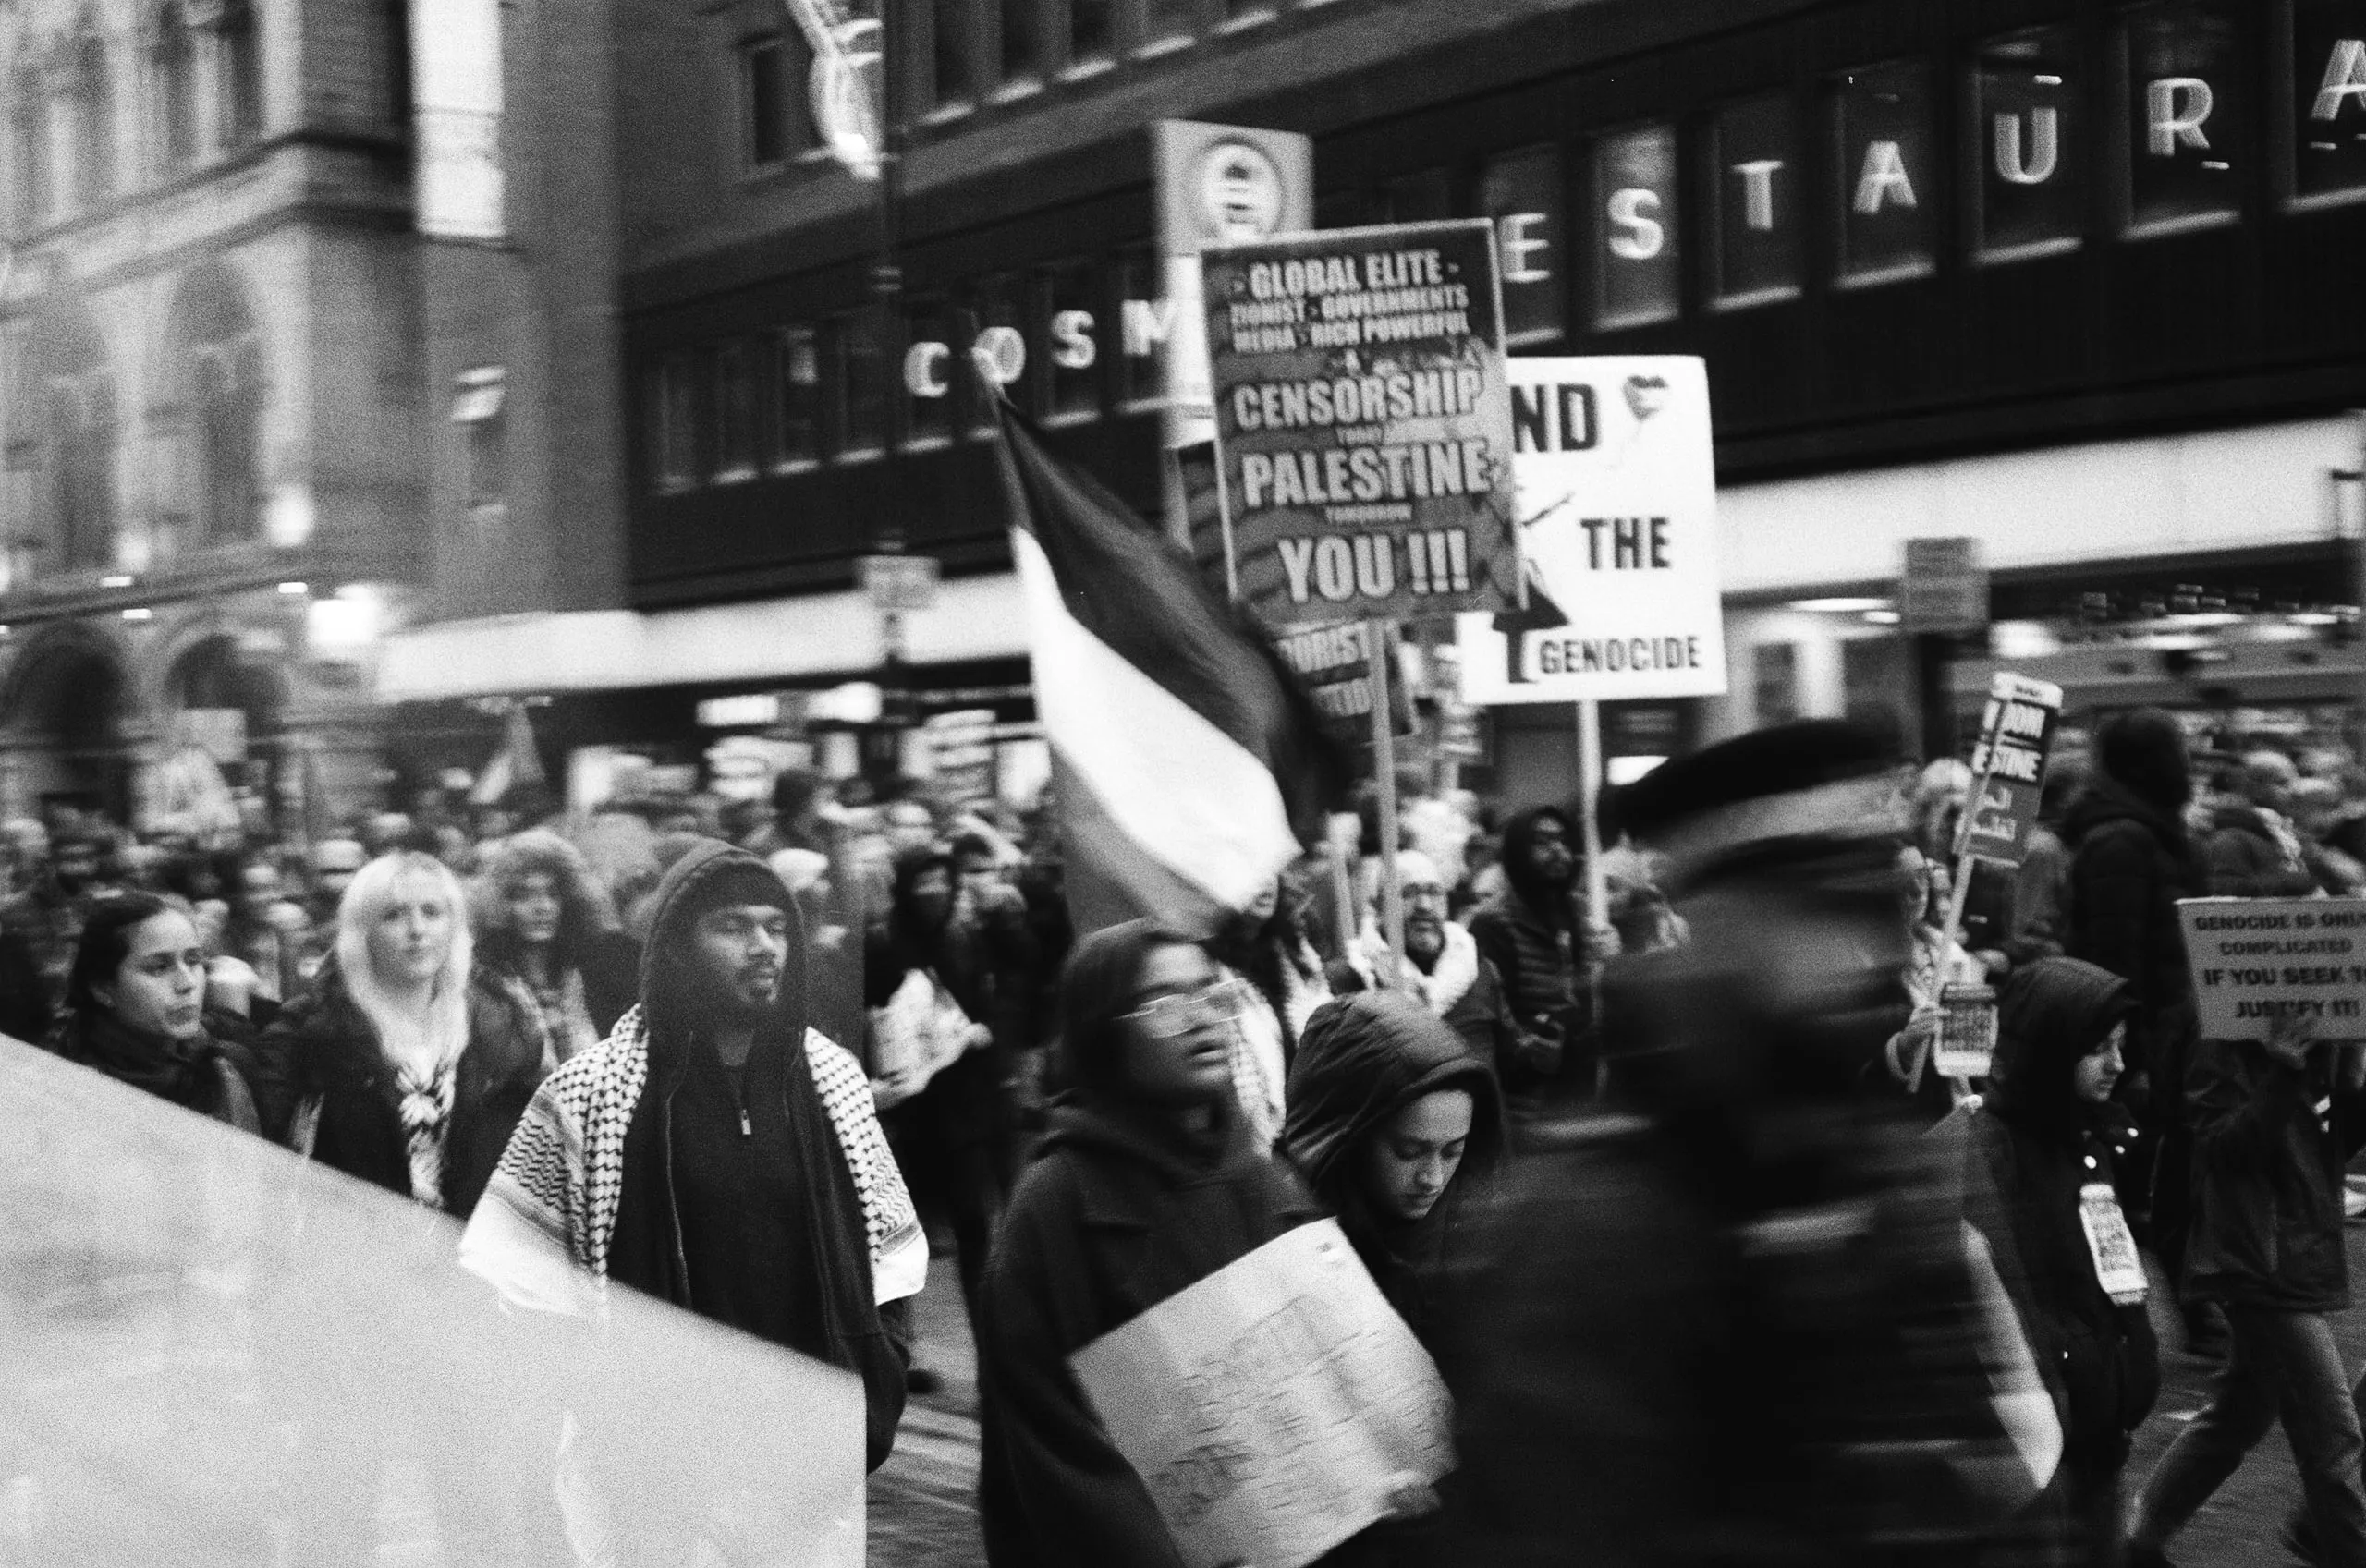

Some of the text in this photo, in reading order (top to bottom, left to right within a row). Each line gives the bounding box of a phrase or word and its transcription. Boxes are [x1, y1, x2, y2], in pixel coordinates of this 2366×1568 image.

[903, 39, 2366, 398] COSM ESTAURA
[1250, 249, 1443, 298] GLOBAL ELITE
[1234, 371, 1481, 429] CENSORSHIP
[1510, 383, 1599, 453] ND
[1242, 439, 1491, 507] PALESTINE
[1278, 533, 1396, 602] YOU
[1580, 517, 1671, 569] THE
[1540, 636, 1702, 675] GENOCIDE
[2195, 914, 2289, 930] GENOCIDE
[2295, 913, 2315, 928] IS
[2219, 939, 2353, 955] COMPLICATED
[2204, 969, 2221, 985] IF
[2230, 968, 2277, 985] YOU
[2283, 967, 2344, 985] SEEK
